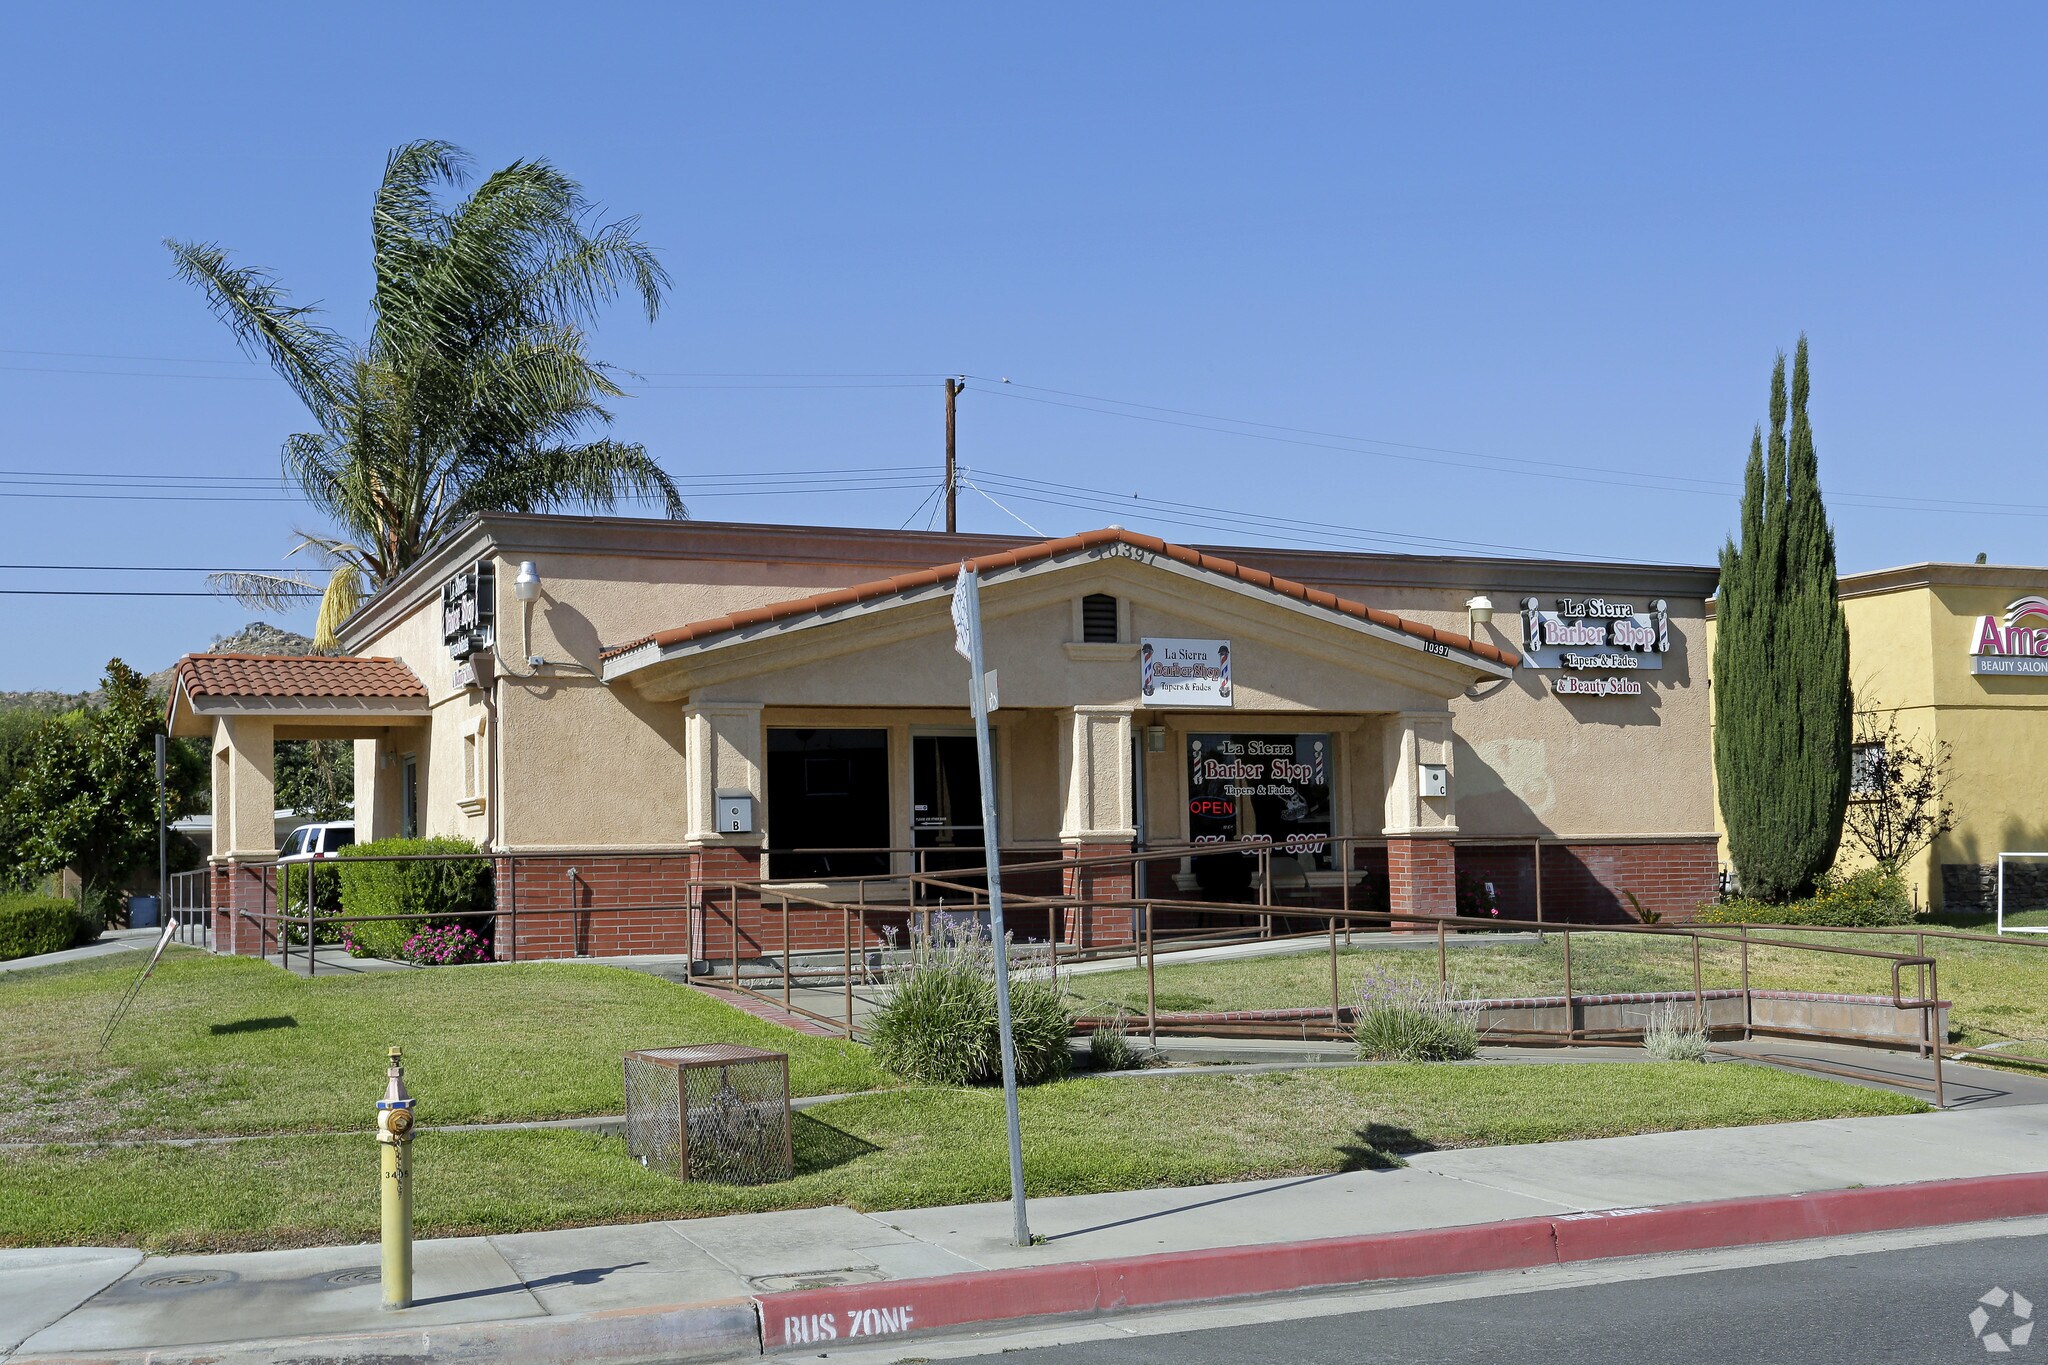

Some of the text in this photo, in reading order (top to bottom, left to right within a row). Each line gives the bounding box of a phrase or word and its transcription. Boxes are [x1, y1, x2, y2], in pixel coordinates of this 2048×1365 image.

[1564, 599, 1634, 617] La Sierra
[1545, 621, 1655, 652] Barber Shop
[1165, 648, 1207, 660] La Sierra
[1424, 641, 1449, 656] 10397
[1567, 653, 1638, 670] Tapers & Fades
[1981, 660, 2014, 672] BEAUTY
[1161, 682, 1184, 692] Tapers
[1192, 683, 1212, 692] Fades
[1558, 677, 1641, 696] & Beauty Salon
[1222, 741, 1293, 755] La Sierra
[1204, 759, 1312, 784] Barber Shop
[1224, 785, 1294, 797] Tapers & Fades
[1440, 786, 1445, 795] C
[1190, 801, 1233, 814] OPEN
[732, 820, 740, 831] B
[784, 1313, 837, 1345] BUS
